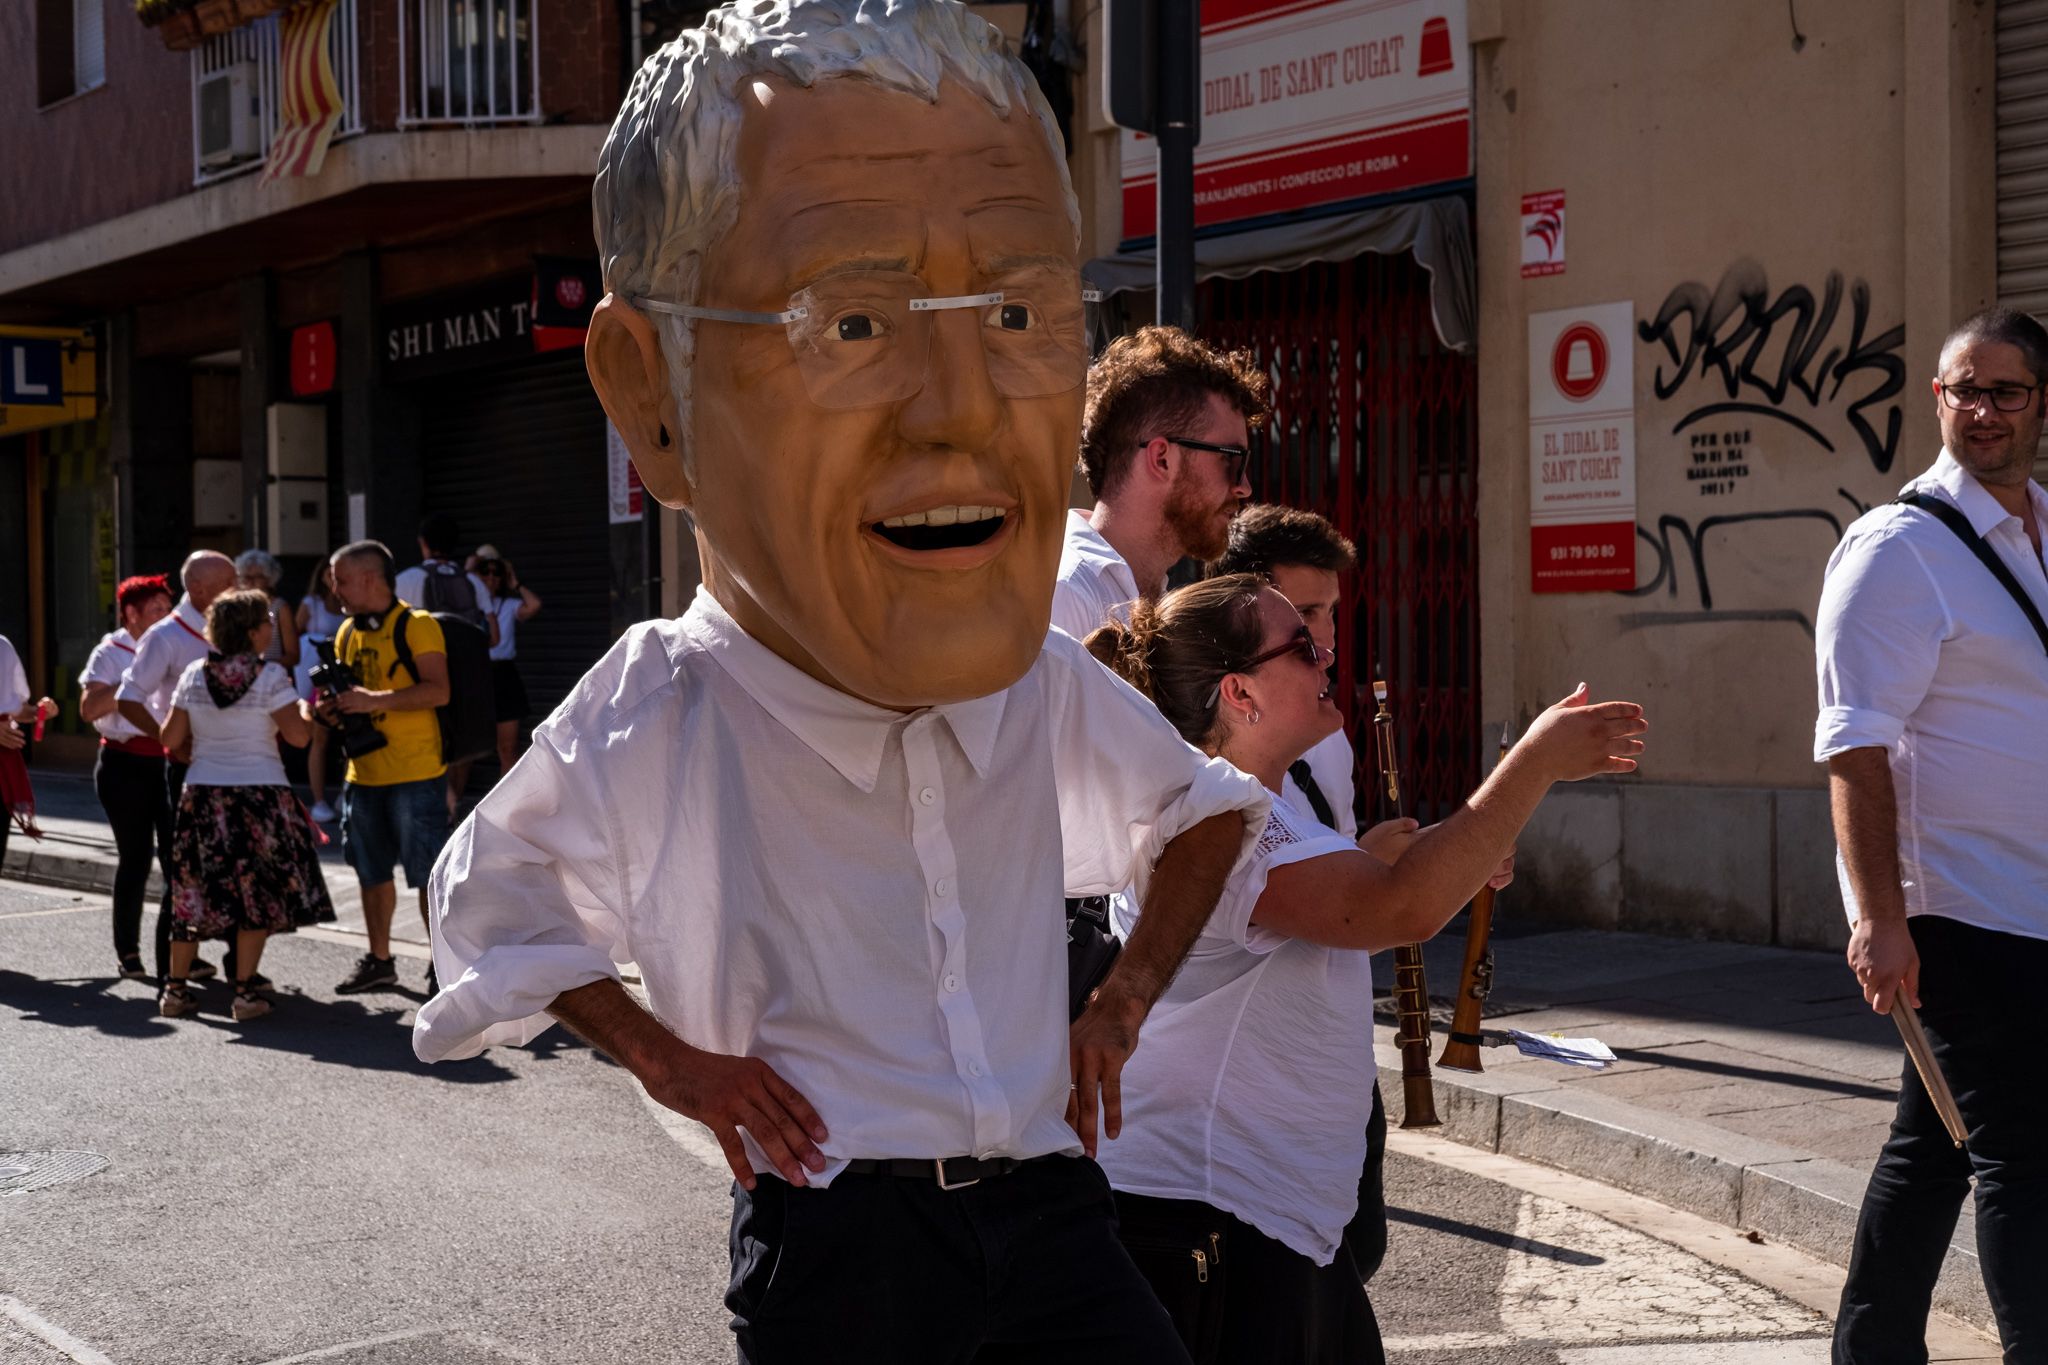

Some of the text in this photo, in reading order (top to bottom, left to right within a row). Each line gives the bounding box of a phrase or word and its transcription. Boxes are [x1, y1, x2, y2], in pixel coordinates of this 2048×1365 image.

[1204, 35, 1404, 116] DIDAL DE SANT CUGAT
[1194, 179, 1271, 205] RRANJAMENTS
[1273, 180, 1278, 191] I
[1347, 161, 1363, 176] DE
[1365, 155, 1398, 173] ROBA
[388, 320, 434, 361] SHI
[443, 306, 502, 350] MAN
[13, 346, 49, 395] L
[1544, 428, 1619, 456] EL DIDAL DE
[1542, 456, 1622, 484] SANT CUGAT
[1569, 545, 1583, 559] 79
[1585, 545, 1599, 559] 90
